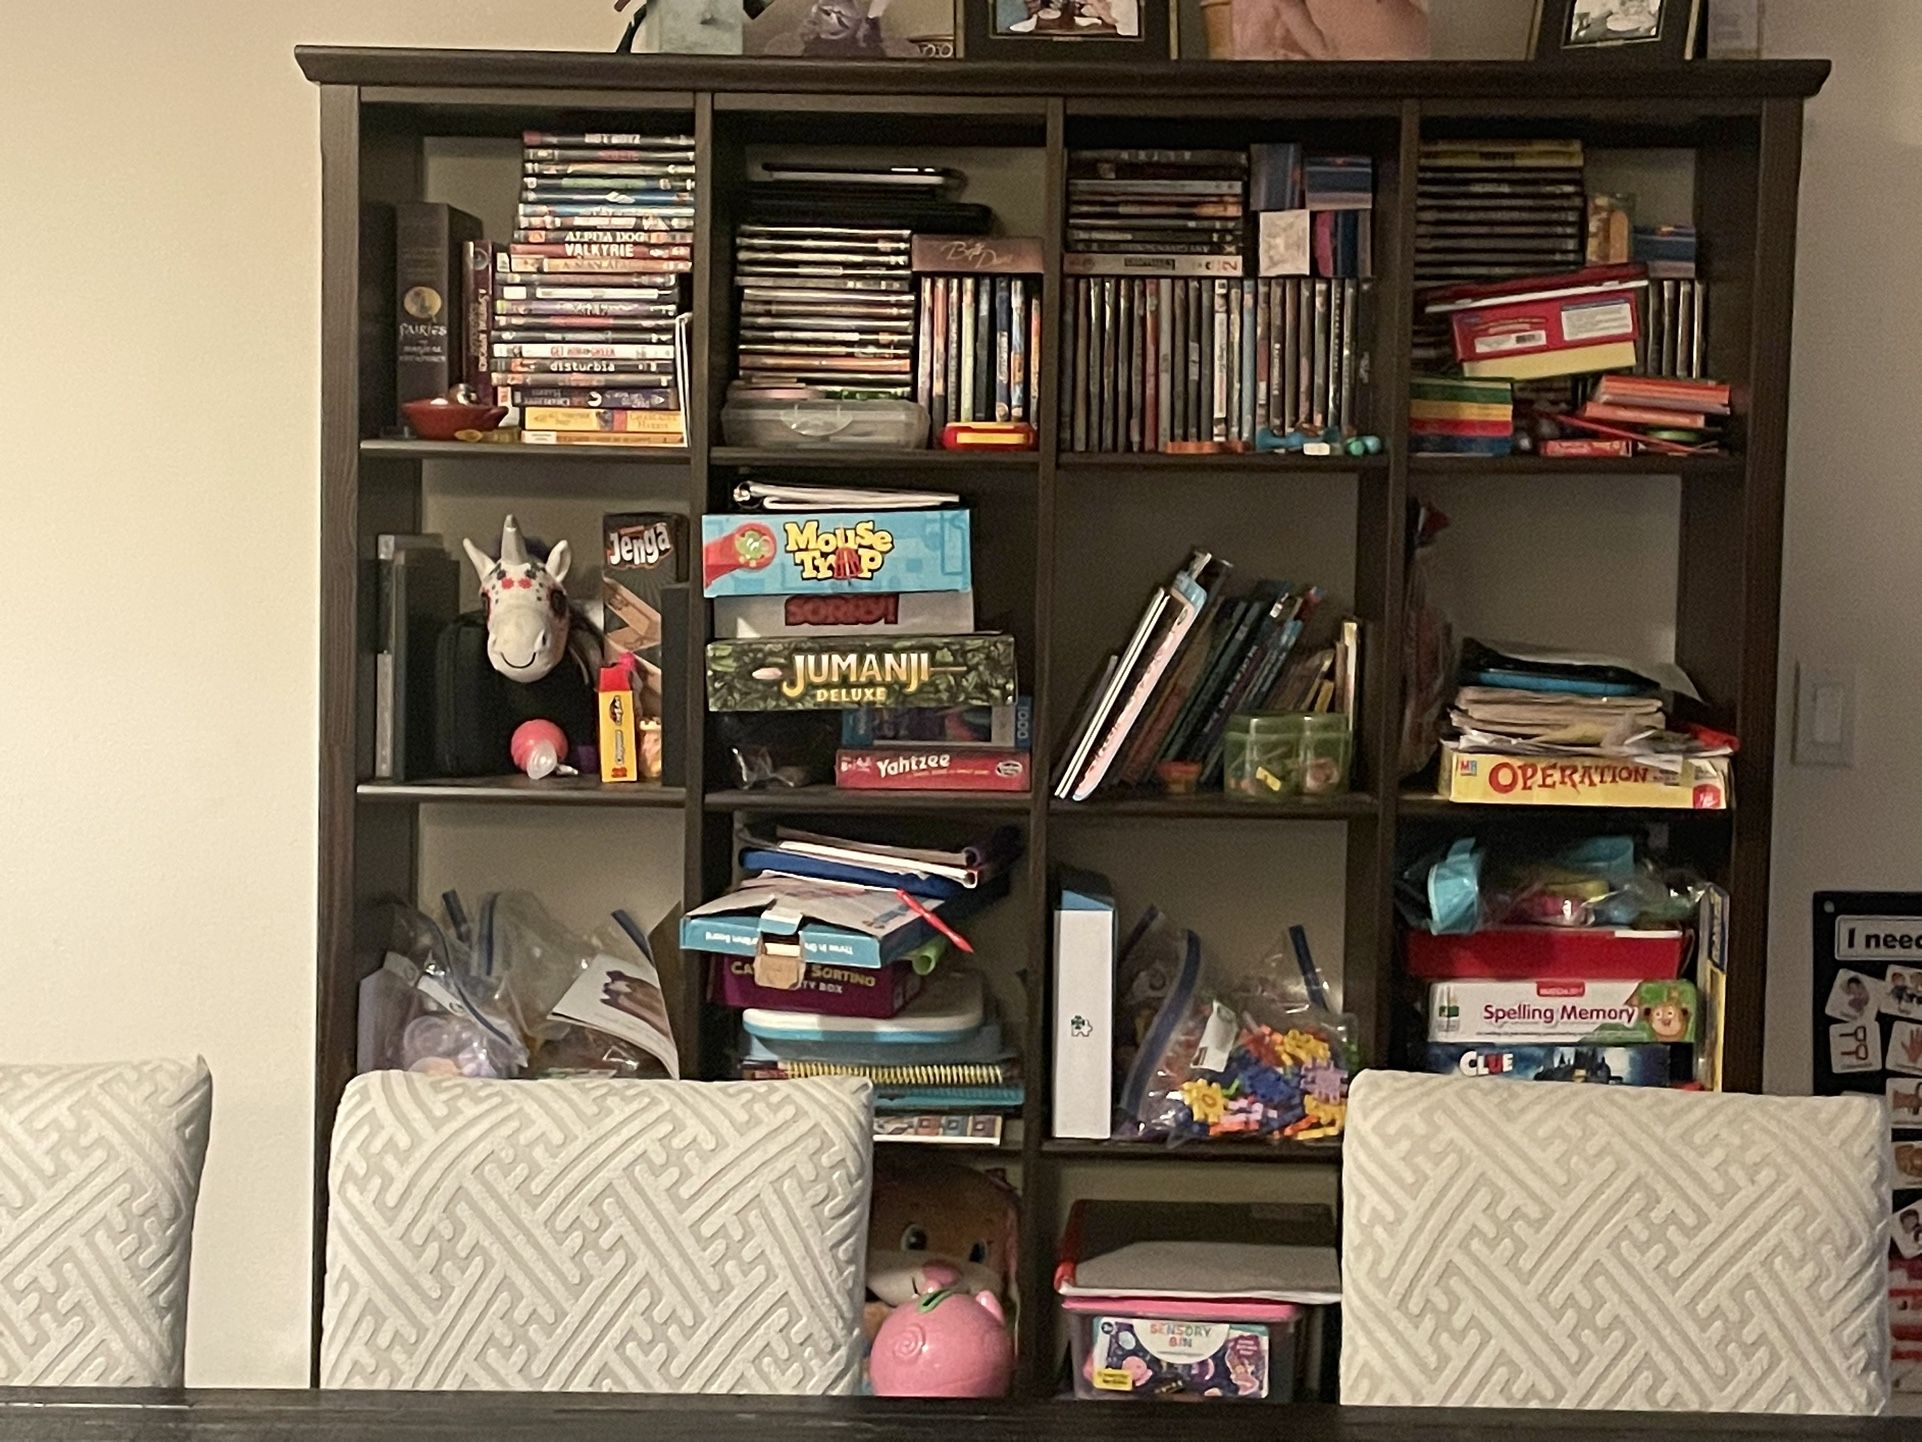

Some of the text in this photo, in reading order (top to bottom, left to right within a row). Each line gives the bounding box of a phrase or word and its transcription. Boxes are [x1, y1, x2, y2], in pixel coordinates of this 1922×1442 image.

[565, 231, 646, 243] ALPHA DOG
[565, 243, 634, 257] VALKYRIE
[550, 360, 615, 372] disturbia
[609, 522, 671, 565] Jenga
[784, 520, 894, 555] Mouse
[782, 652, 929, 697] JUMANJI
[816, 688, 887, 702] DELUXE
[877, 754, 951, 778] Yahtzee
[1488, 761, 1650, 795] OPERATION
[1848, 928, 1856, 949] I
[811, 965, 876, 987] SORTING
[819, 982, 843, 993] BOX
[1483, 1003, 1636, 1024] Spelling Memory
[1459, 1050, 1514, 1077] CLUE
[1151, 1322, 1212, 1337] SENSORY
[1168, 1336, 1193, 1348] BIN
